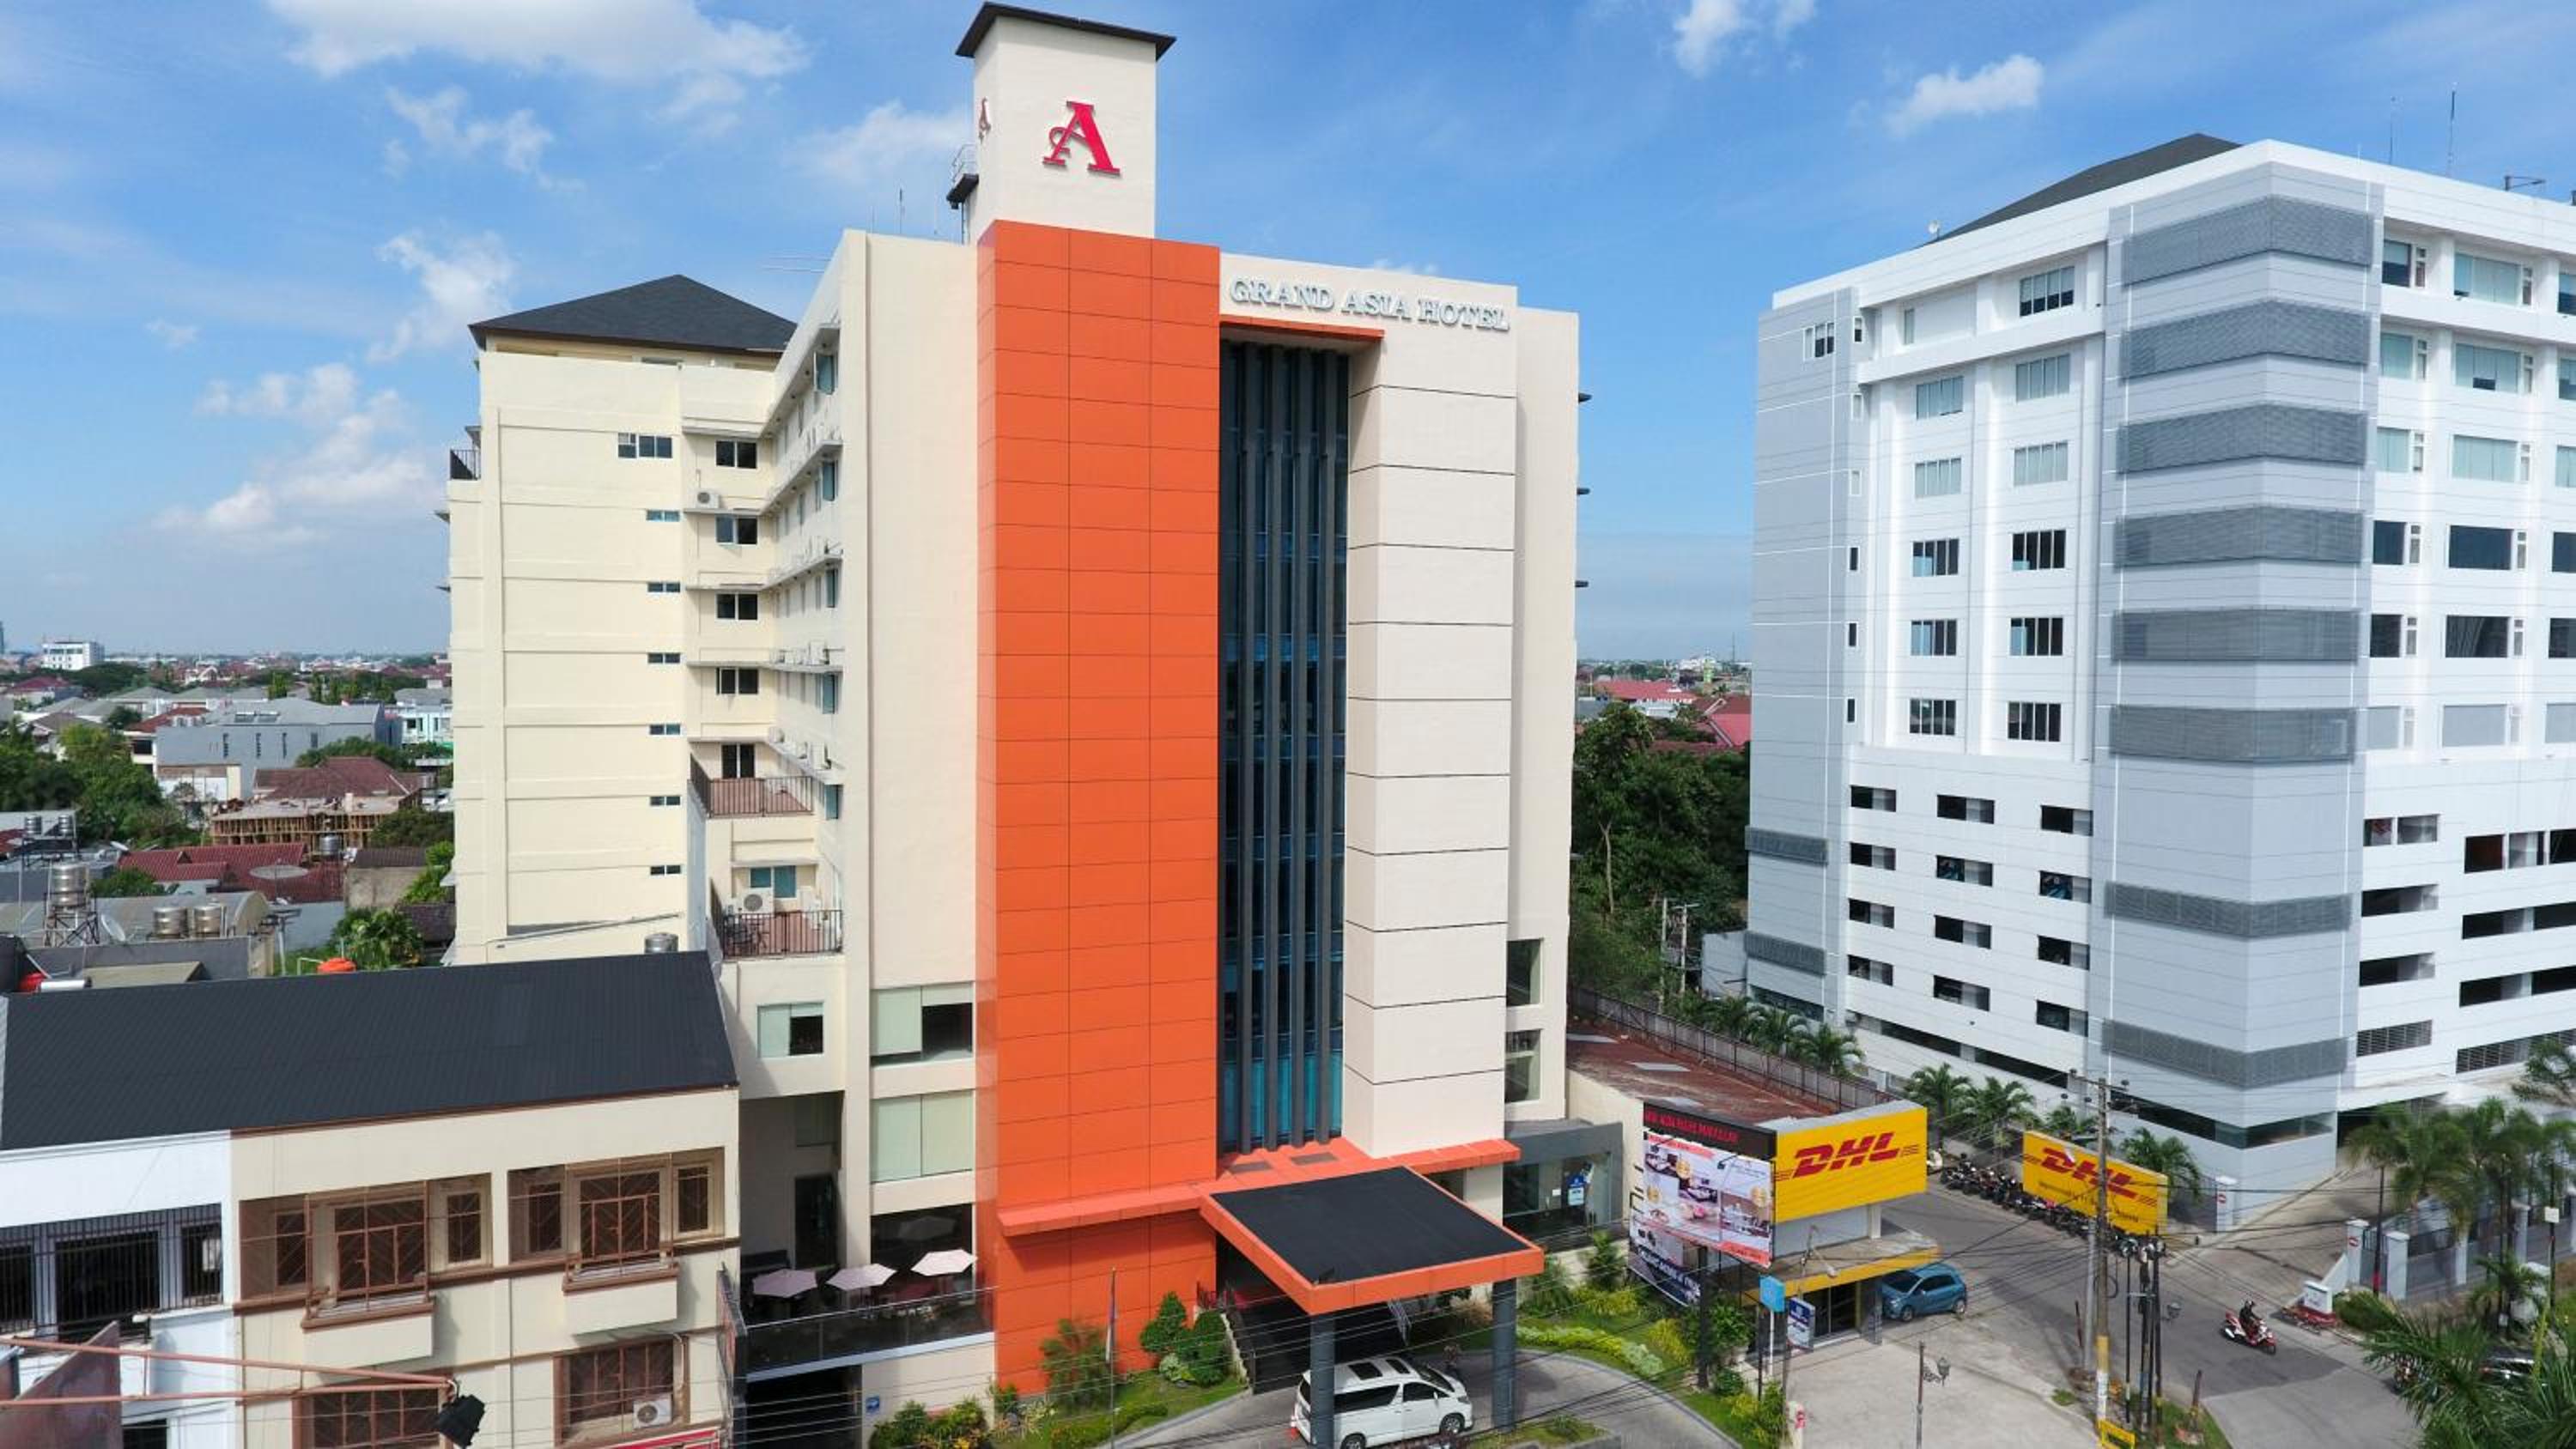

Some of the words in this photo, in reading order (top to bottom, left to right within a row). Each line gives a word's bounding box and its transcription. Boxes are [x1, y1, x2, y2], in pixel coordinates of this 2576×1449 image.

[1042, 100, 1121, 176] A
[1230, 278, 1334, 312] GRAND
[1341, 290, 1412, 320] ASIA
[1418, 298, 1510, 332] HOTEL
[1793, 1132, 1901, 1178] DHL
[2041, 1147, 2139, 1199] DHL
